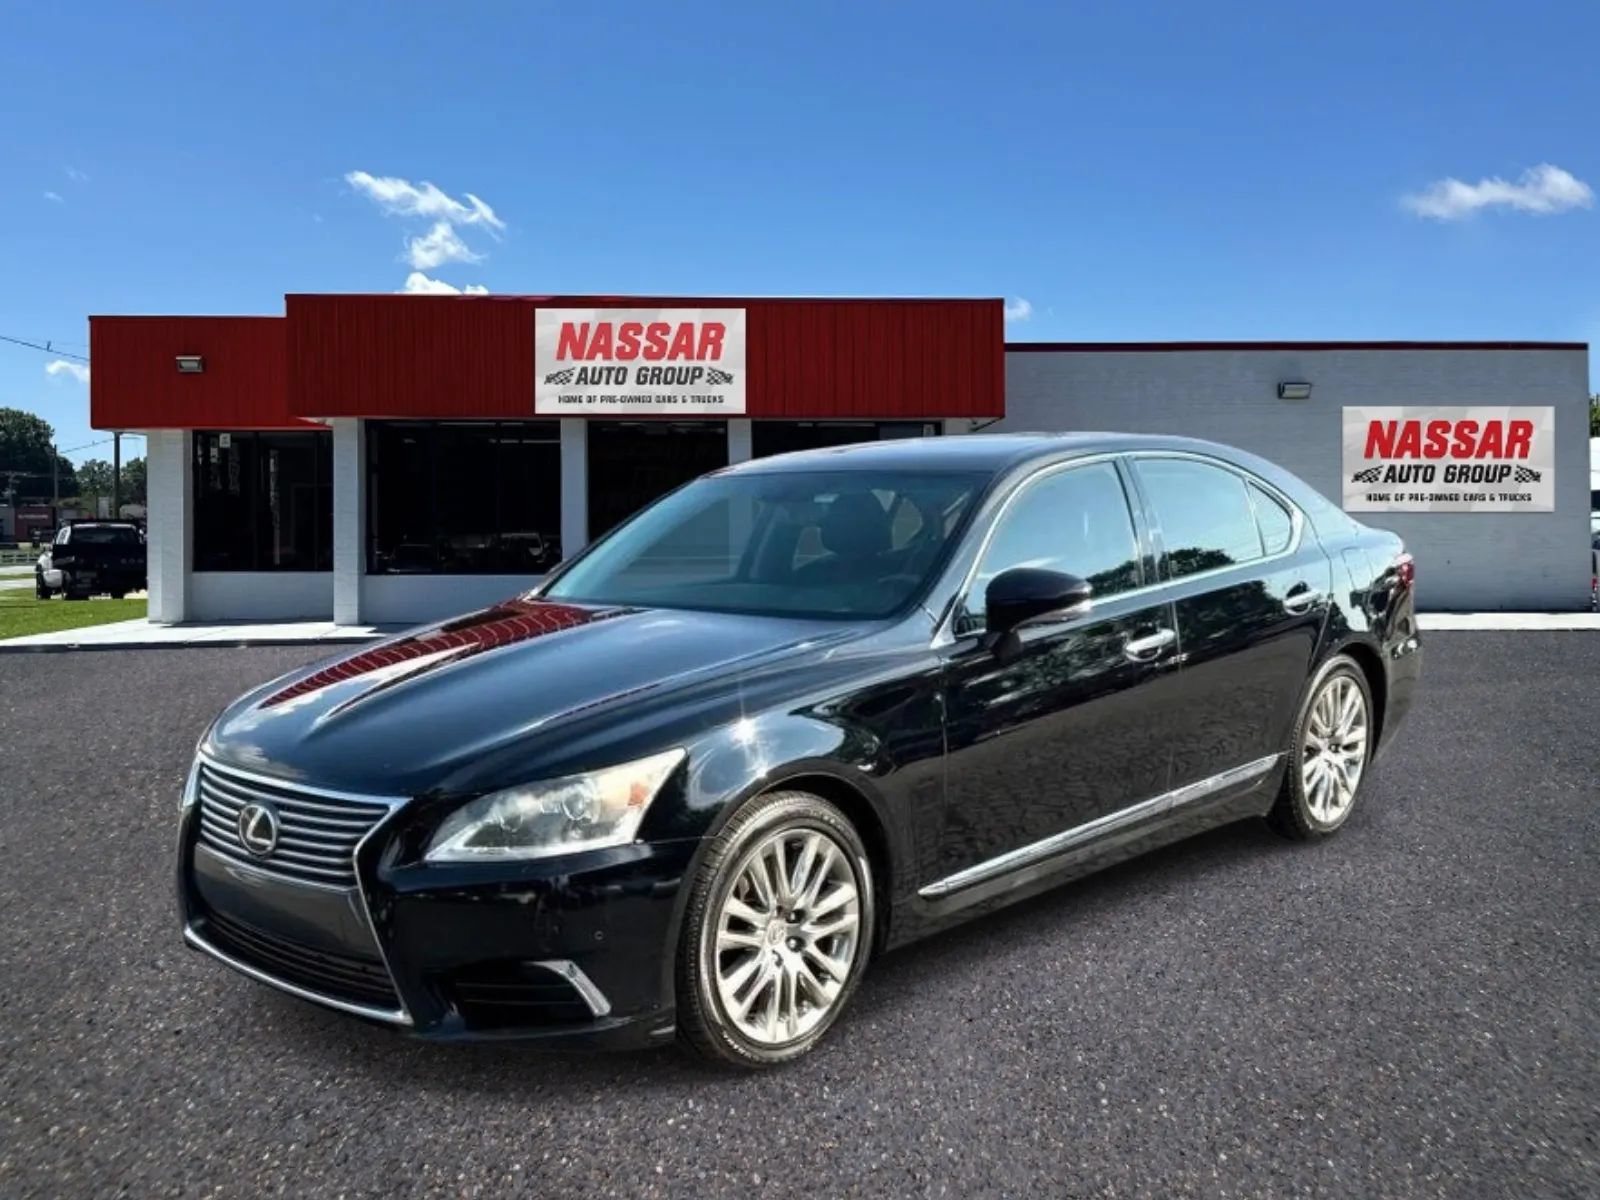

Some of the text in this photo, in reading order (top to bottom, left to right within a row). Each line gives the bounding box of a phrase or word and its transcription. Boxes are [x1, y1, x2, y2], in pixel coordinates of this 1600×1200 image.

[556, 322, 726, 361] NASSAR
[575, 366, 704, 385] AUTO GROUP
[1364, 420, 1534, 459] NASSAR
[1383, 464, 1512, 483] AUTO GROUP
